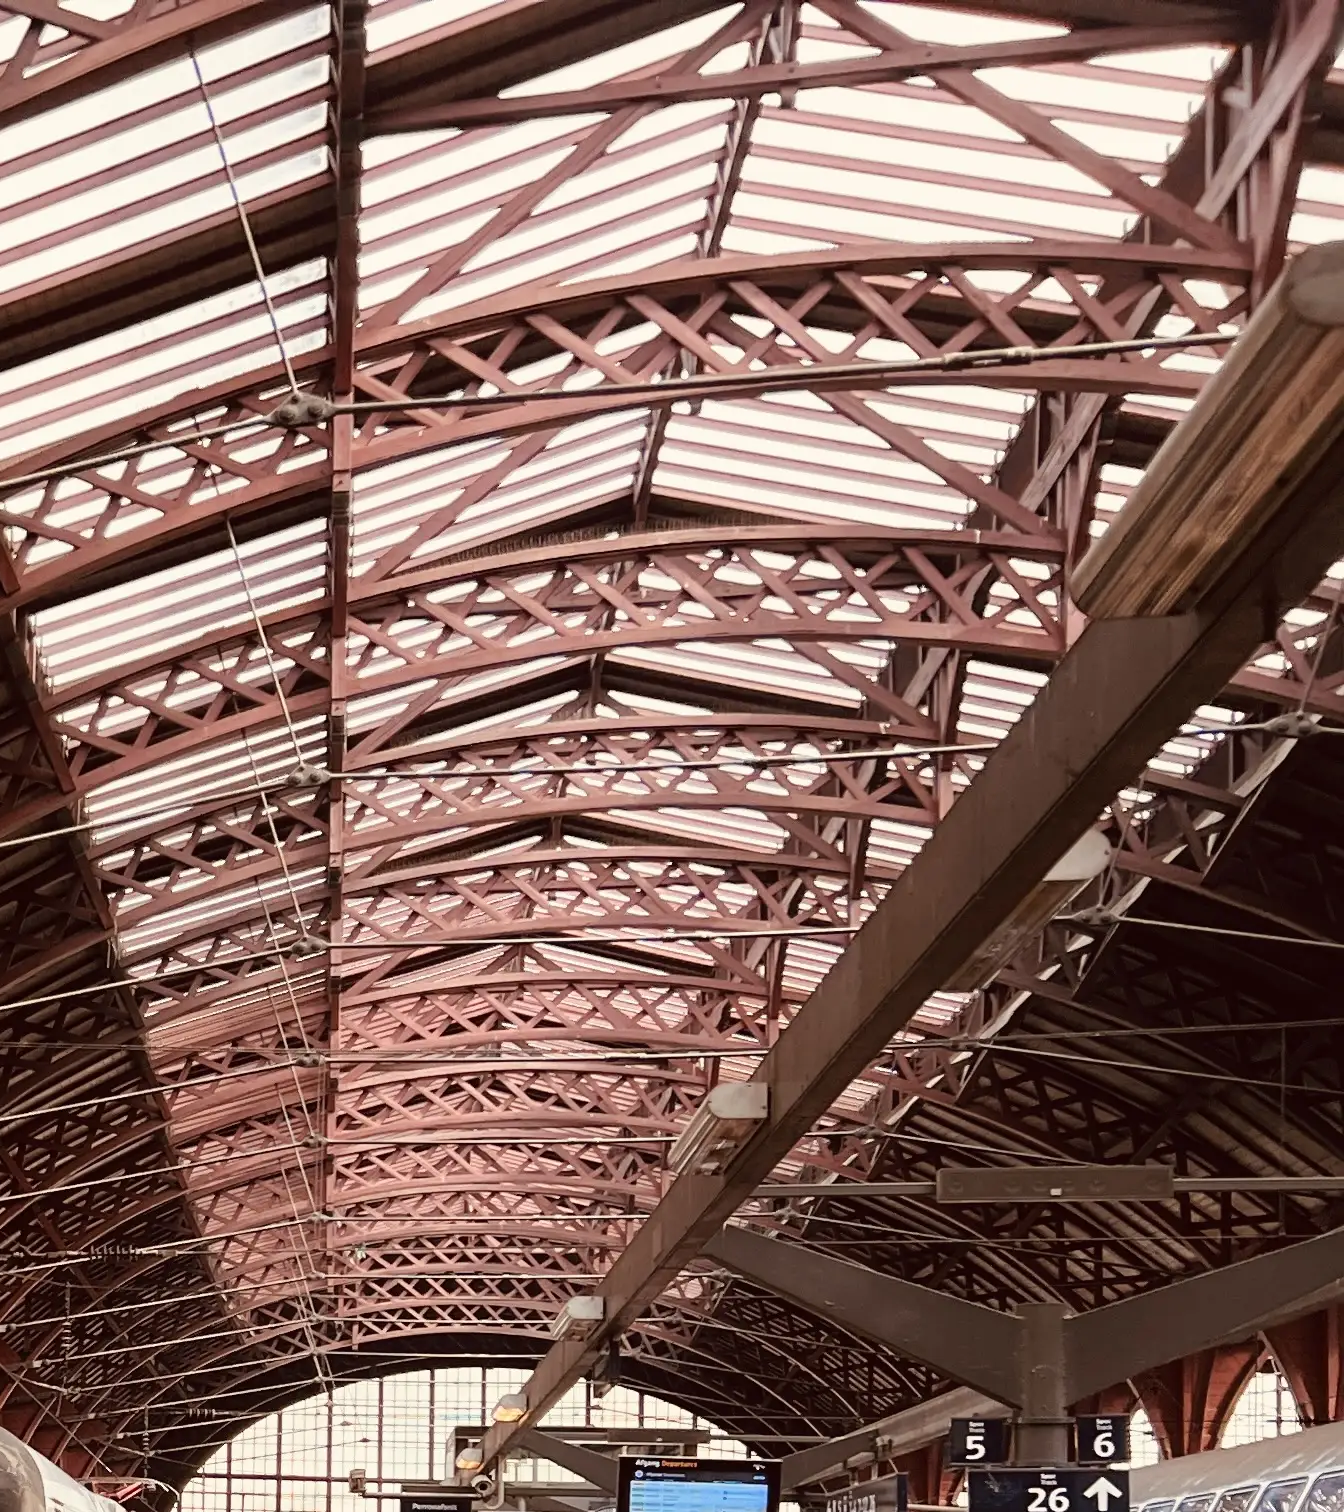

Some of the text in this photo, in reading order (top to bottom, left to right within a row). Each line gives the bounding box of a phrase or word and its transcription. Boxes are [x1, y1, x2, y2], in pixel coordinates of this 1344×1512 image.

[965, 1435, 986, 1460] 5
[1093, 1432, 1116, 1458] 6
[1027, 1487, 1070, 1512] 26
